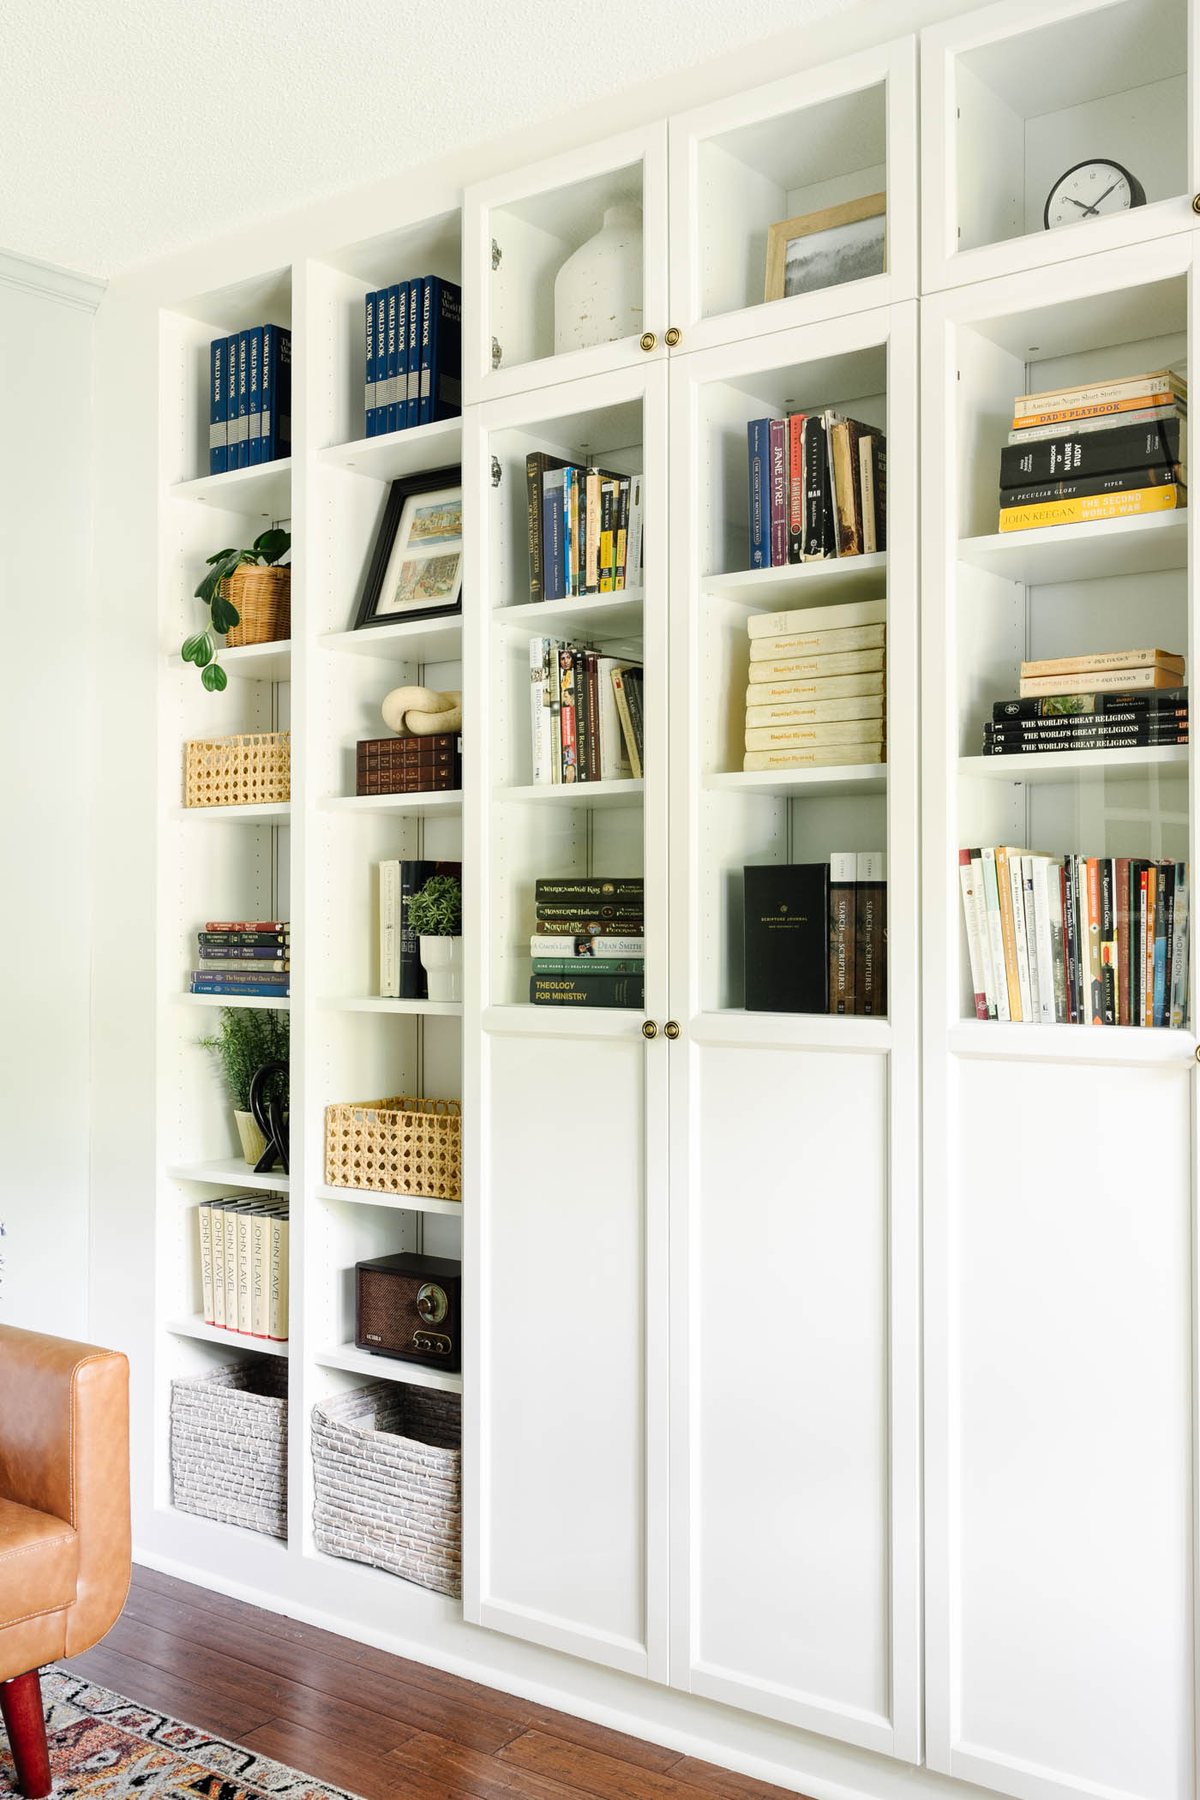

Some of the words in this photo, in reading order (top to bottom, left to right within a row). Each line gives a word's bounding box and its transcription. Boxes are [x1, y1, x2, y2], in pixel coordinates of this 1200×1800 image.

[1040, 412, 1066, 422] DAD'S
[1069, 404, 1120, 418] PLAYBOOK
[774, 447, 783, 476] JANE
[775, 478, 784, 506] EYRE
[808, 490, 820, 498] MAN
[1018, 490, 1051, 500] PECULIAR
[1054, 487, 1077, 495] GLORY
[792, 478, 800, 522] FAHRENHEIT
[1082, 500, 1098, 508] THE
[1103, 494, 1142, 504] SECOND
[1003, 513, 1032, 525] JOHN
[1034, 508, 1075, 520] KEEGAN
[1082, 507, 1116, 518] WORLD
[1120, 504, 1140, 513] WAR
[534, 521, 538, 530] TO
[1038, 718, 1068, 728] WORLD'S
[1070, 716, 1094, 725] GREAT
[1096, 713, 1136, 724] RELIGIONS
[1040, 730, 1071, 740] WORLD'S
[1072, 728, 1096, 736] GREAT
[1098, 725, 1138, 734] RELIGIONS
[1038, 742, 1070, 751] WORLD'S
[1070, 740, 1094, 748] GREAT
[1096, 738, 1137, 748] RELIGIONS
[588, 885, 600, 894] King
[598, 942, 618, 950] DEAN
[619, 940, 642, 950] SMITH
[536, 982, 575, 990] THEOLOGY
[536, 992, 550, 1000] FOR
[552, 992, 587, 1000] MINISTRY
[203, 1248, 211, 1287] FLAVEL
[215, 1250, 223, 1290] FLAVEL
[272, 1261, 280, 1301] FLAVEL
